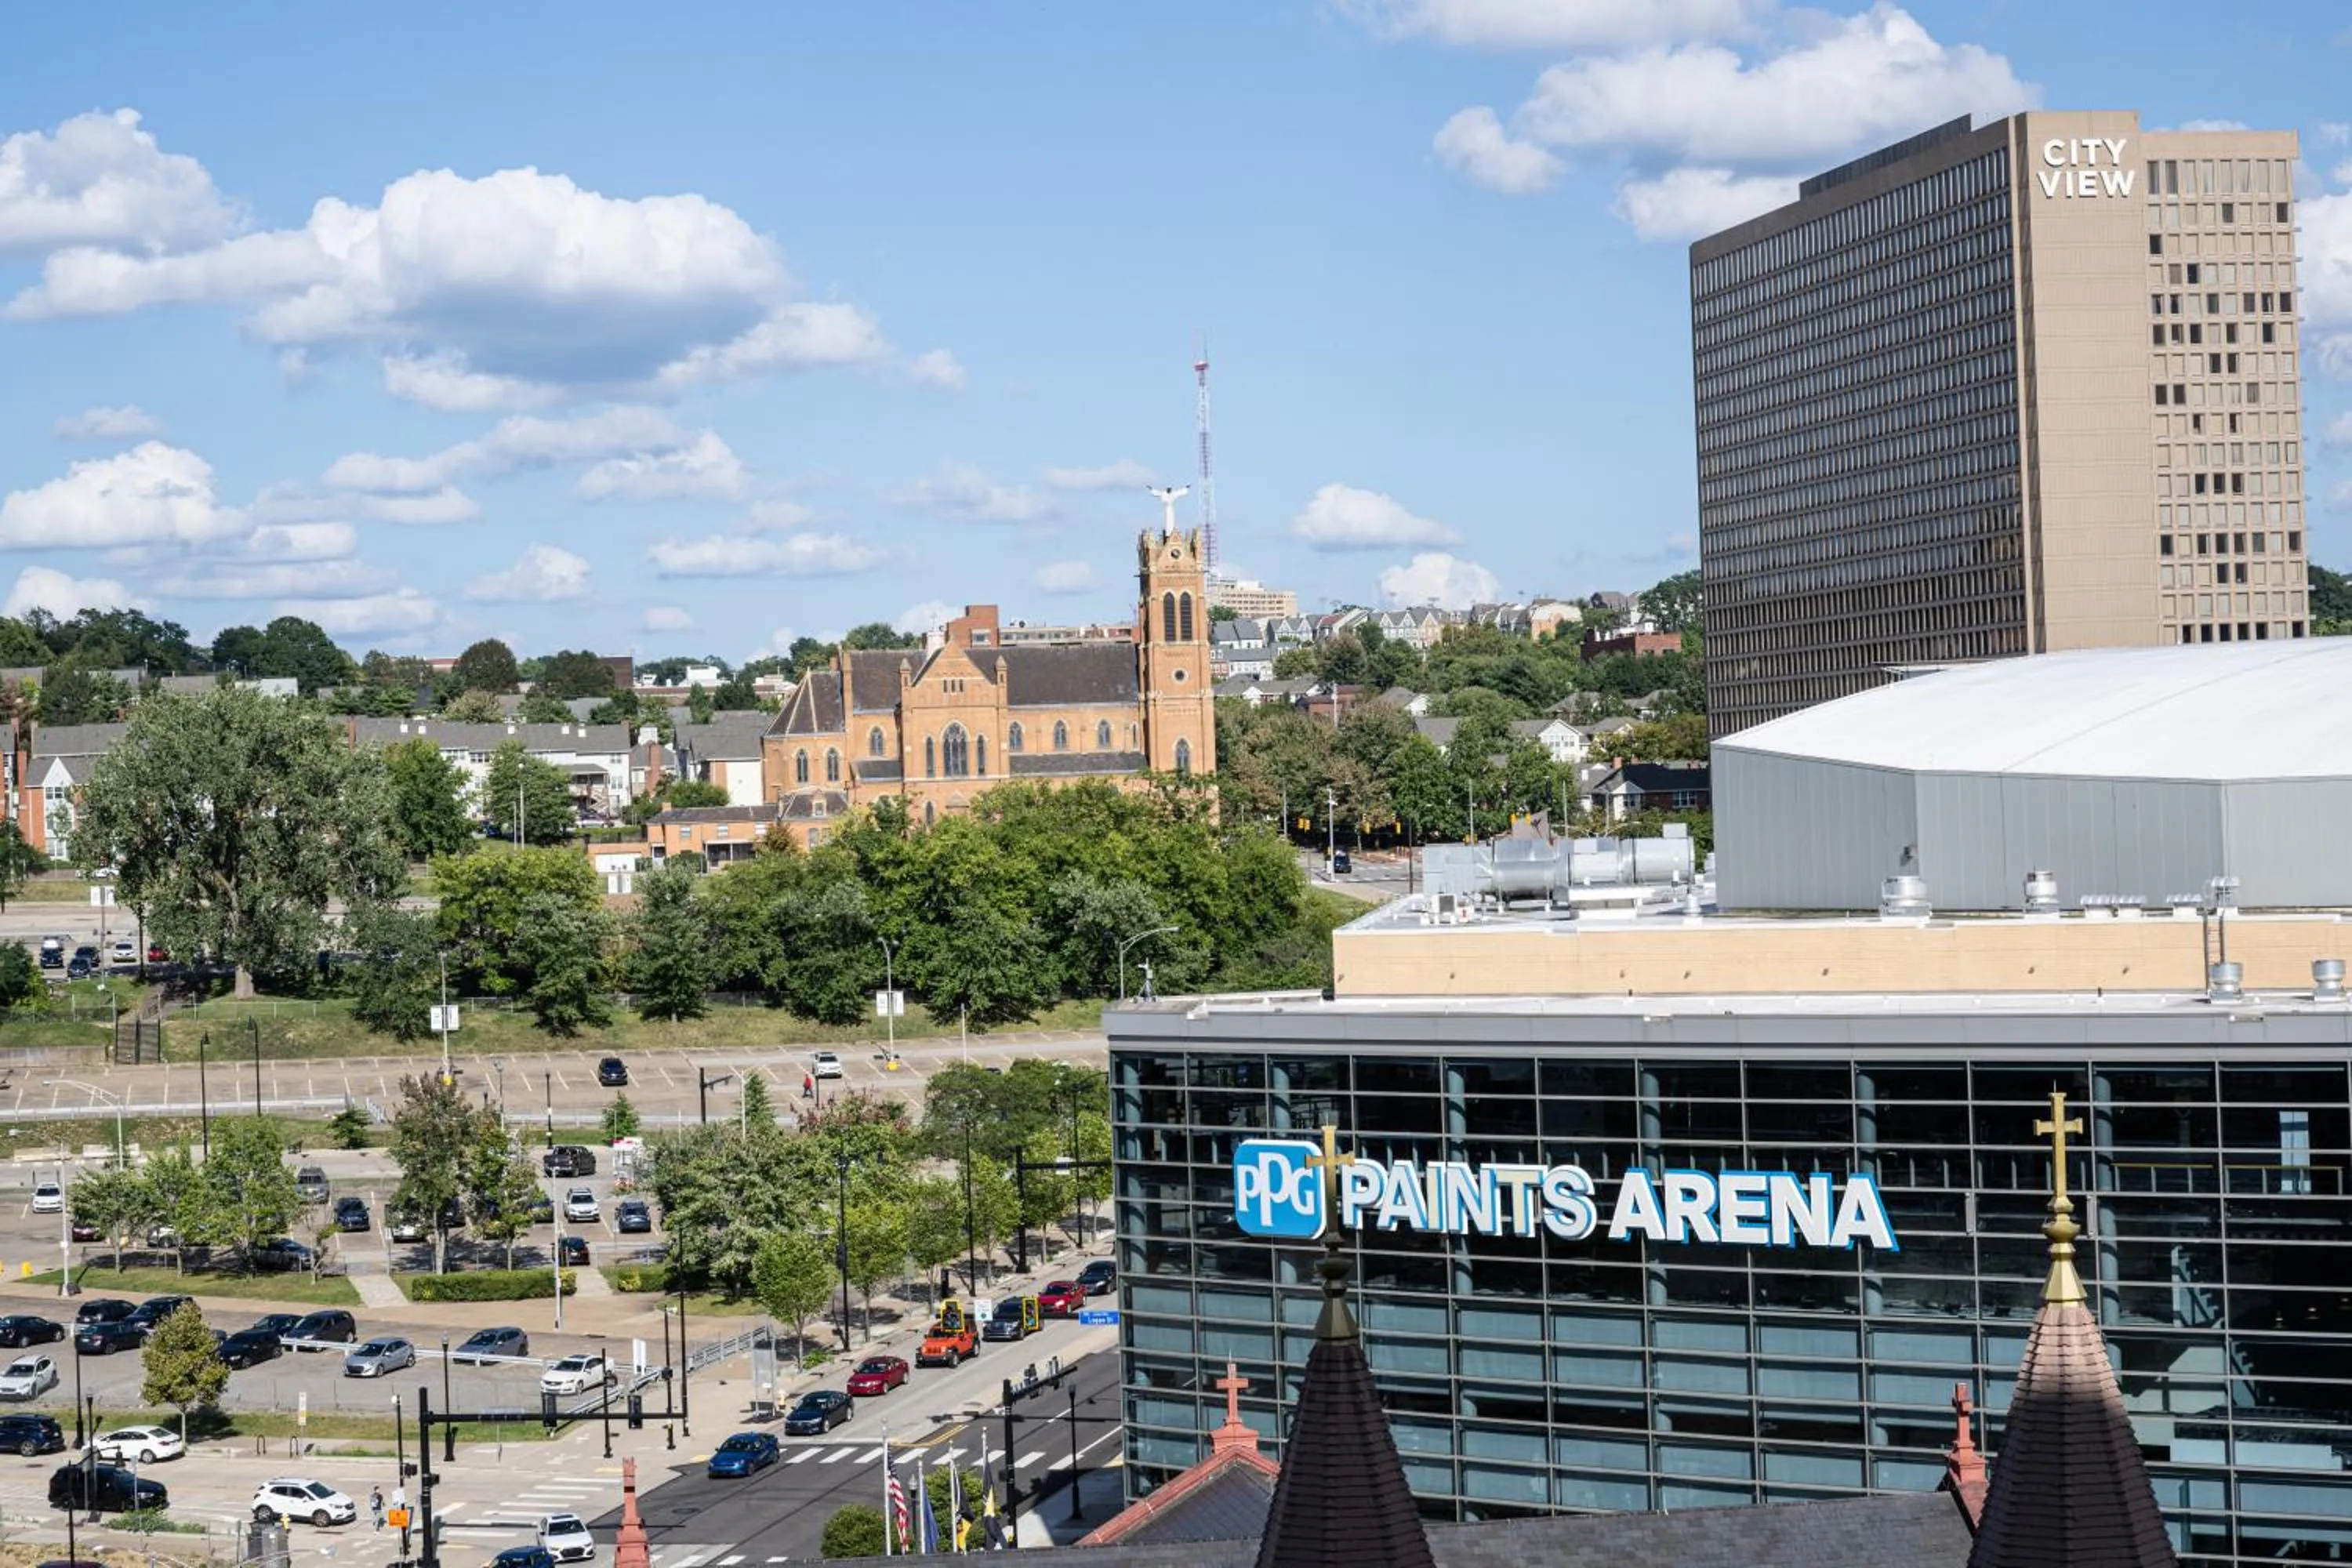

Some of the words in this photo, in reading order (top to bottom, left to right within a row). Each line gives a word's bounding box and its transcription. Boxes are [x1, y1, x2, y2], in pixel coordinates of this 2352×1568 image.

[2043, 138, 2127, 167] CITY
[2036, 170, 2136, 198] VIEW
[1236, 1152, 1315, 1226] PPG
[1341, 1159, 1597, 1240] PAINTS
[1607, 1167, 1899, 1252] ARENA
